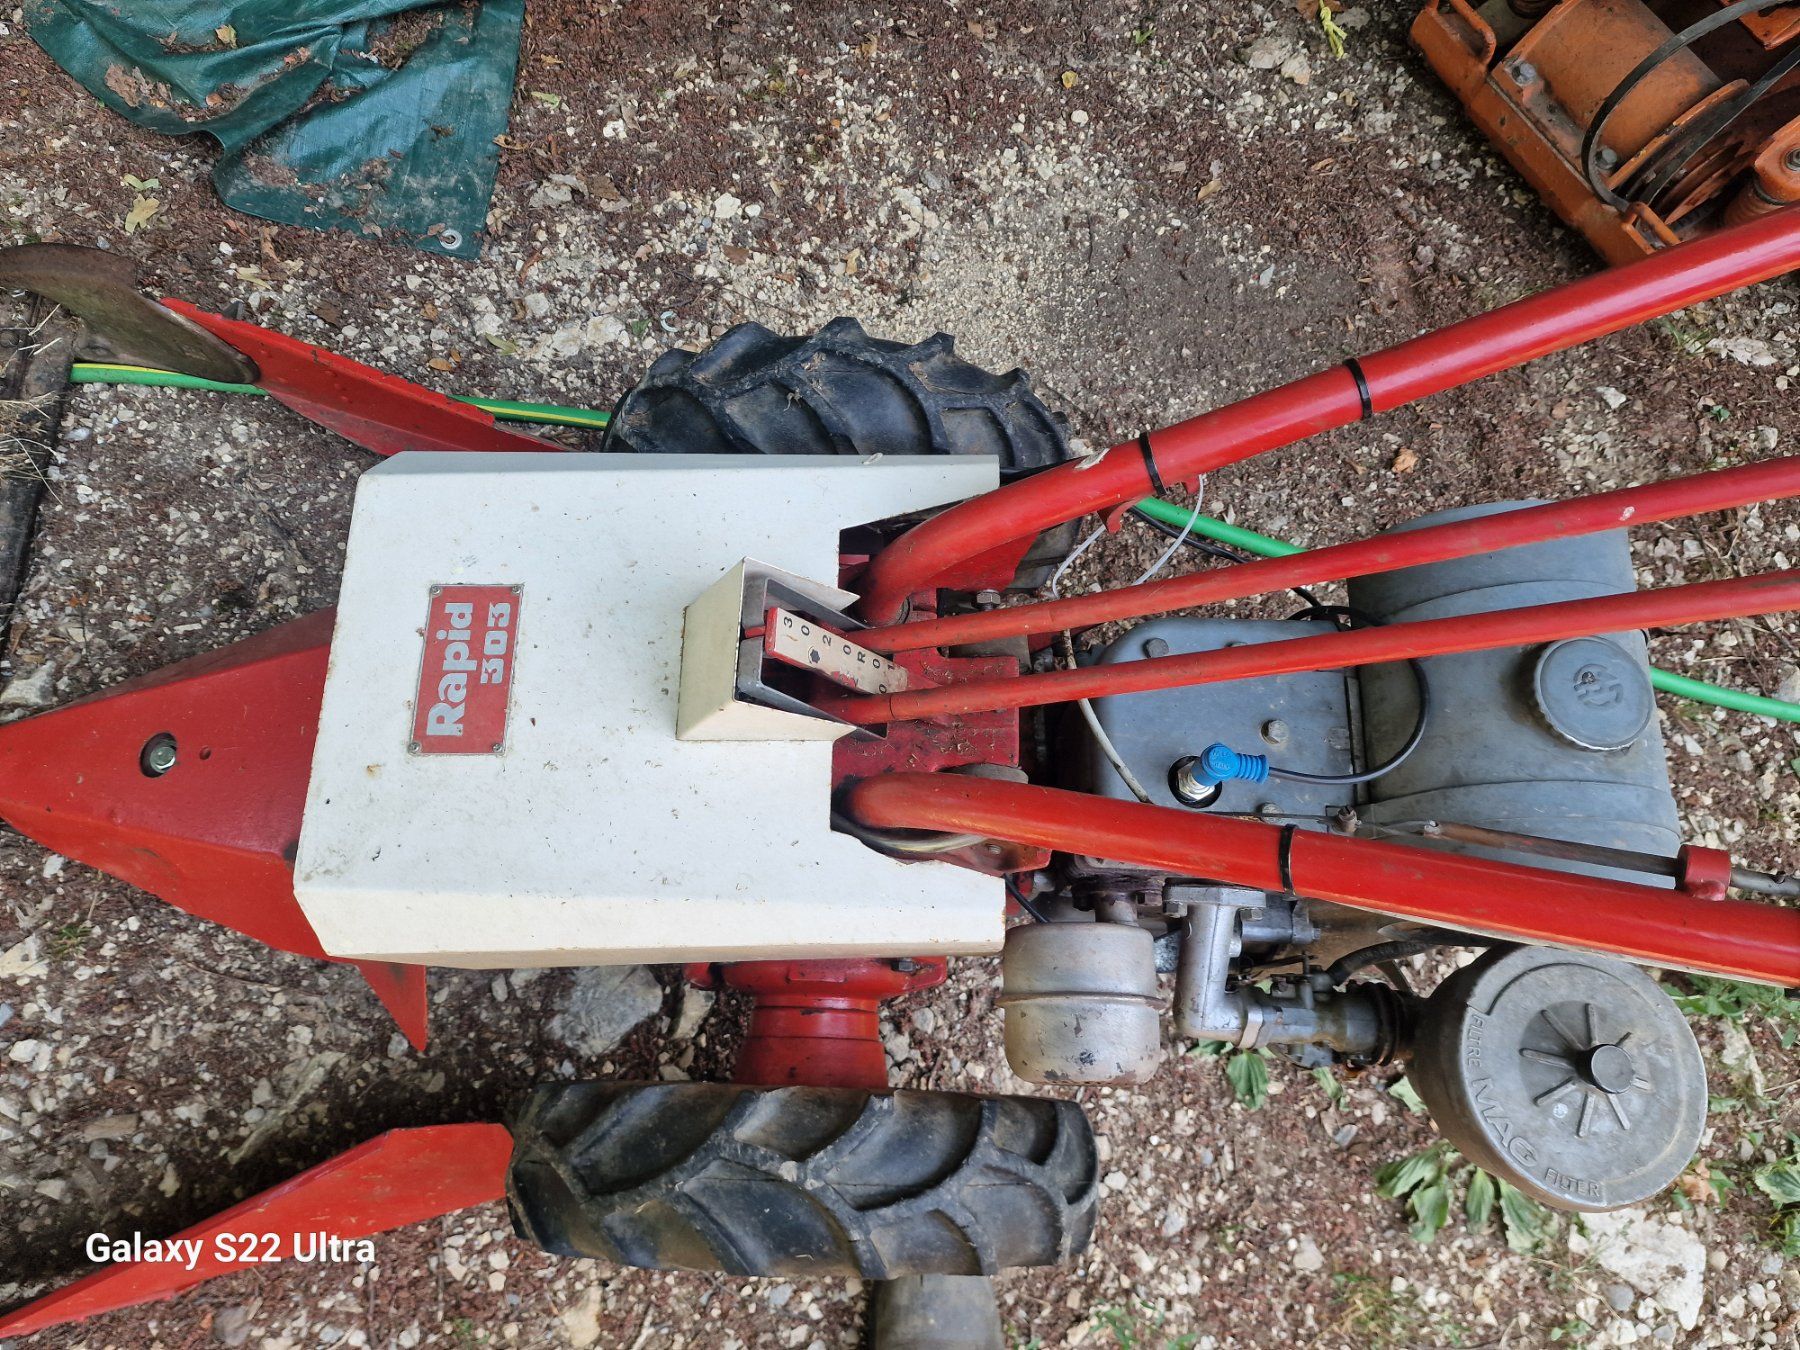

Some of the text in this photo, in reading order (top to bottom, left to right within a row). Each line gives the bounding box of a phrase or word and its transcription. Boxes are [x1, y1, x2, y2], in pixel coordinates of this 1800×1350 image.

[426, 602, 478, 737] Rapid
[480, 602, 511, 684] 303
[1471, 1077, 1539, 1167] MAG
[1545, 1167, 1601, 1197] FILTER
